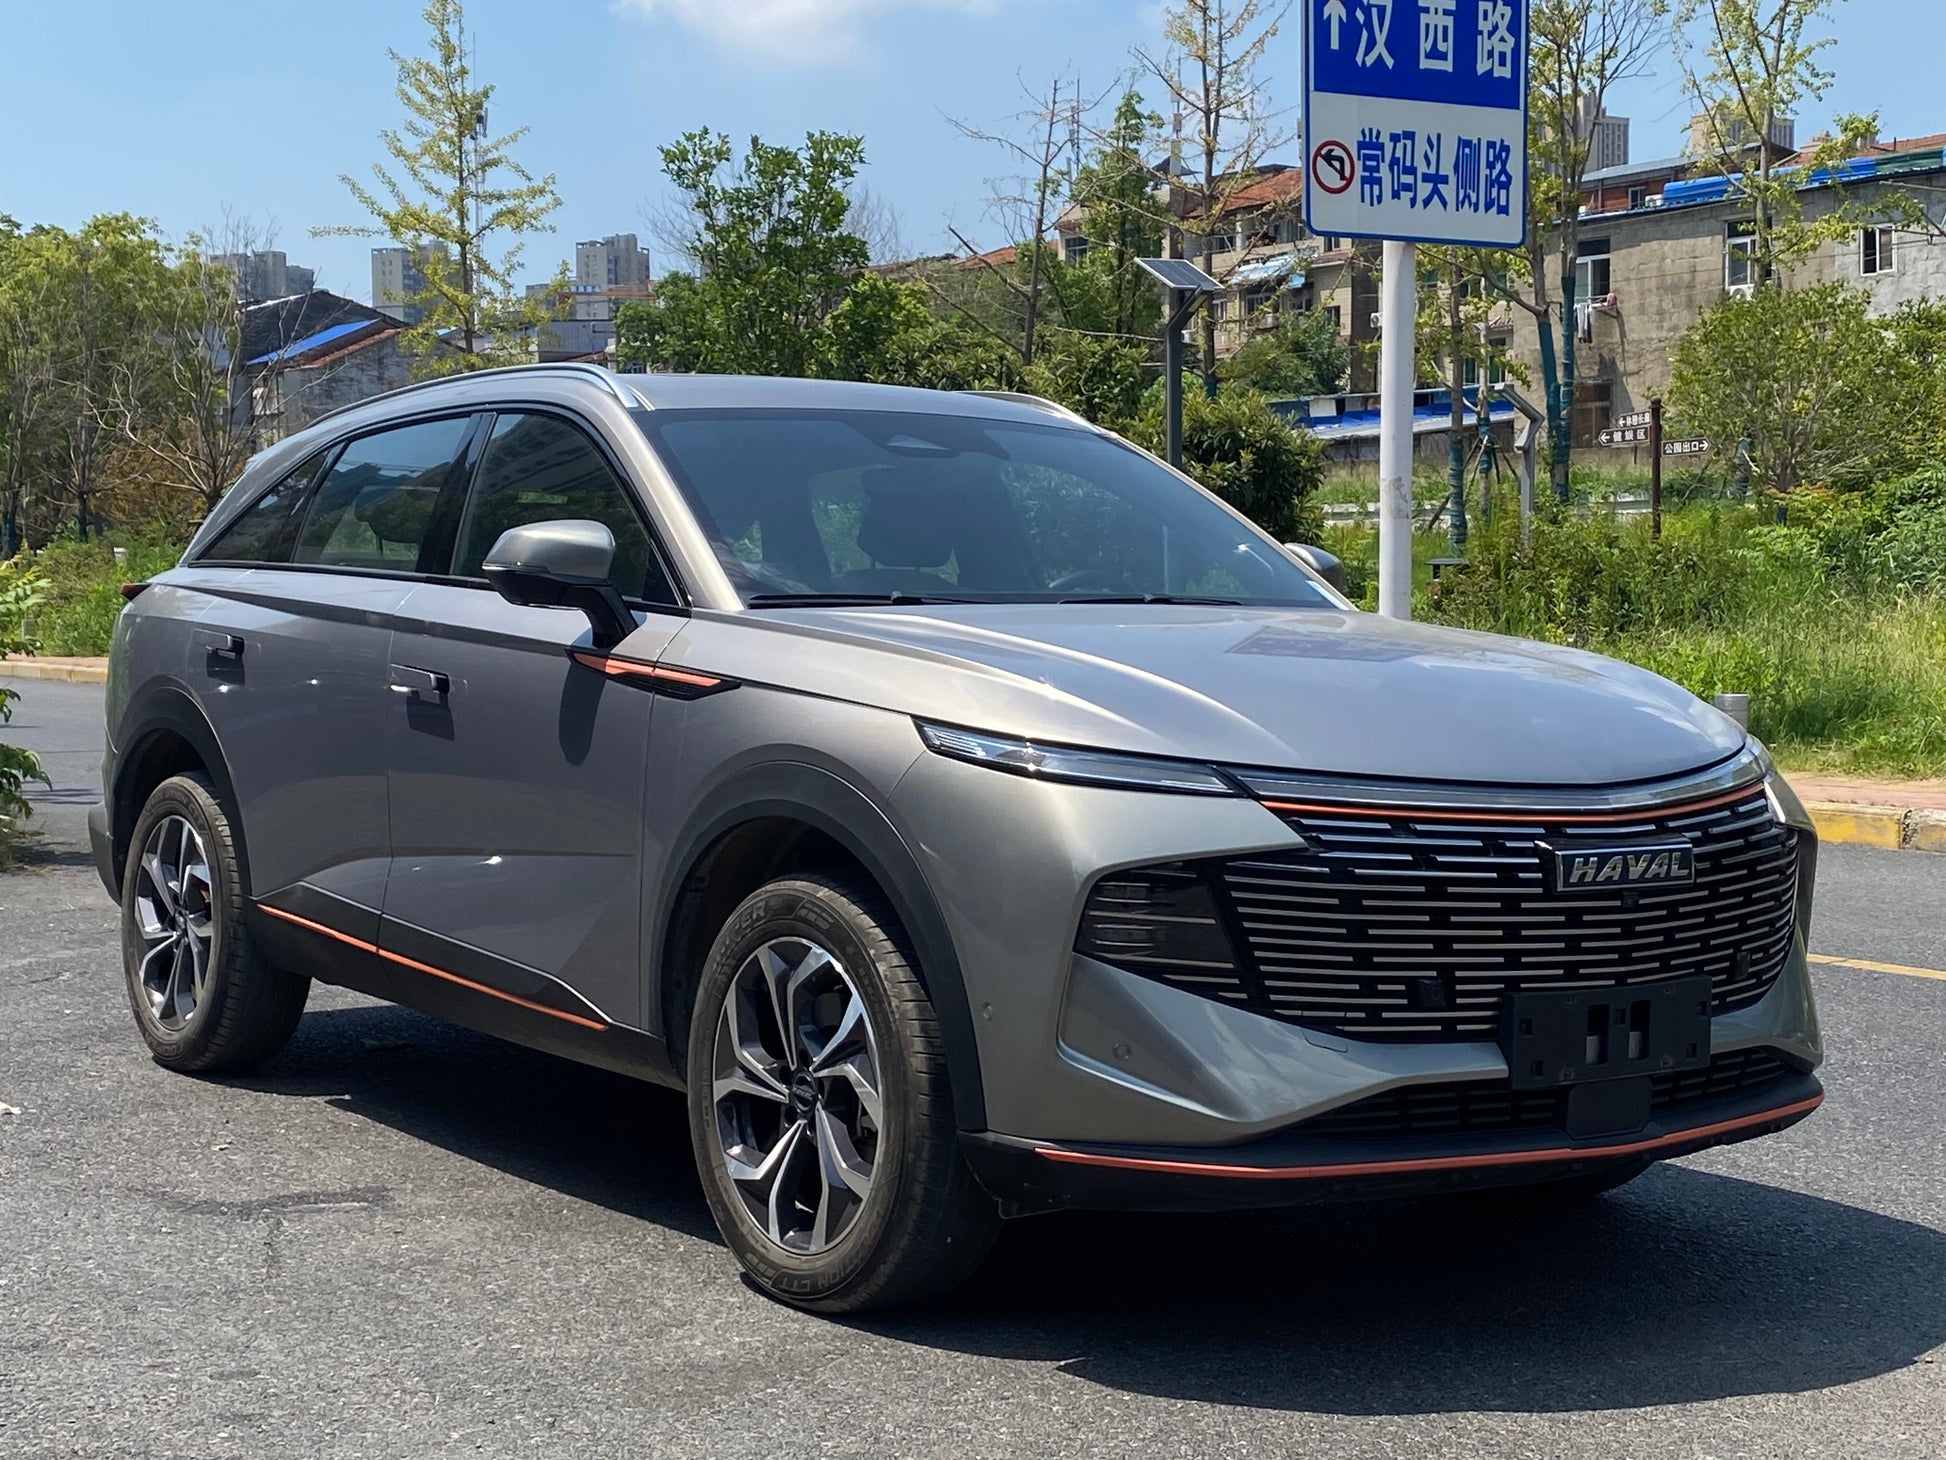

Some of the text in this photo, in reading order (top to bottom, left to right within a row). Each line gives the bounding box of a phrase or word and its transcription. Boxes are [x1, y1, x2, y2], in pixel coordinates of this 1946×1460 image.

[1355, 0, 1515, 78] 汉西路
[1357, 128, 1513, 216] 常码头侧路
[1664, 441, 1699, 454] 公园出口
[1569, 852, 1690, 883] HAVAL
